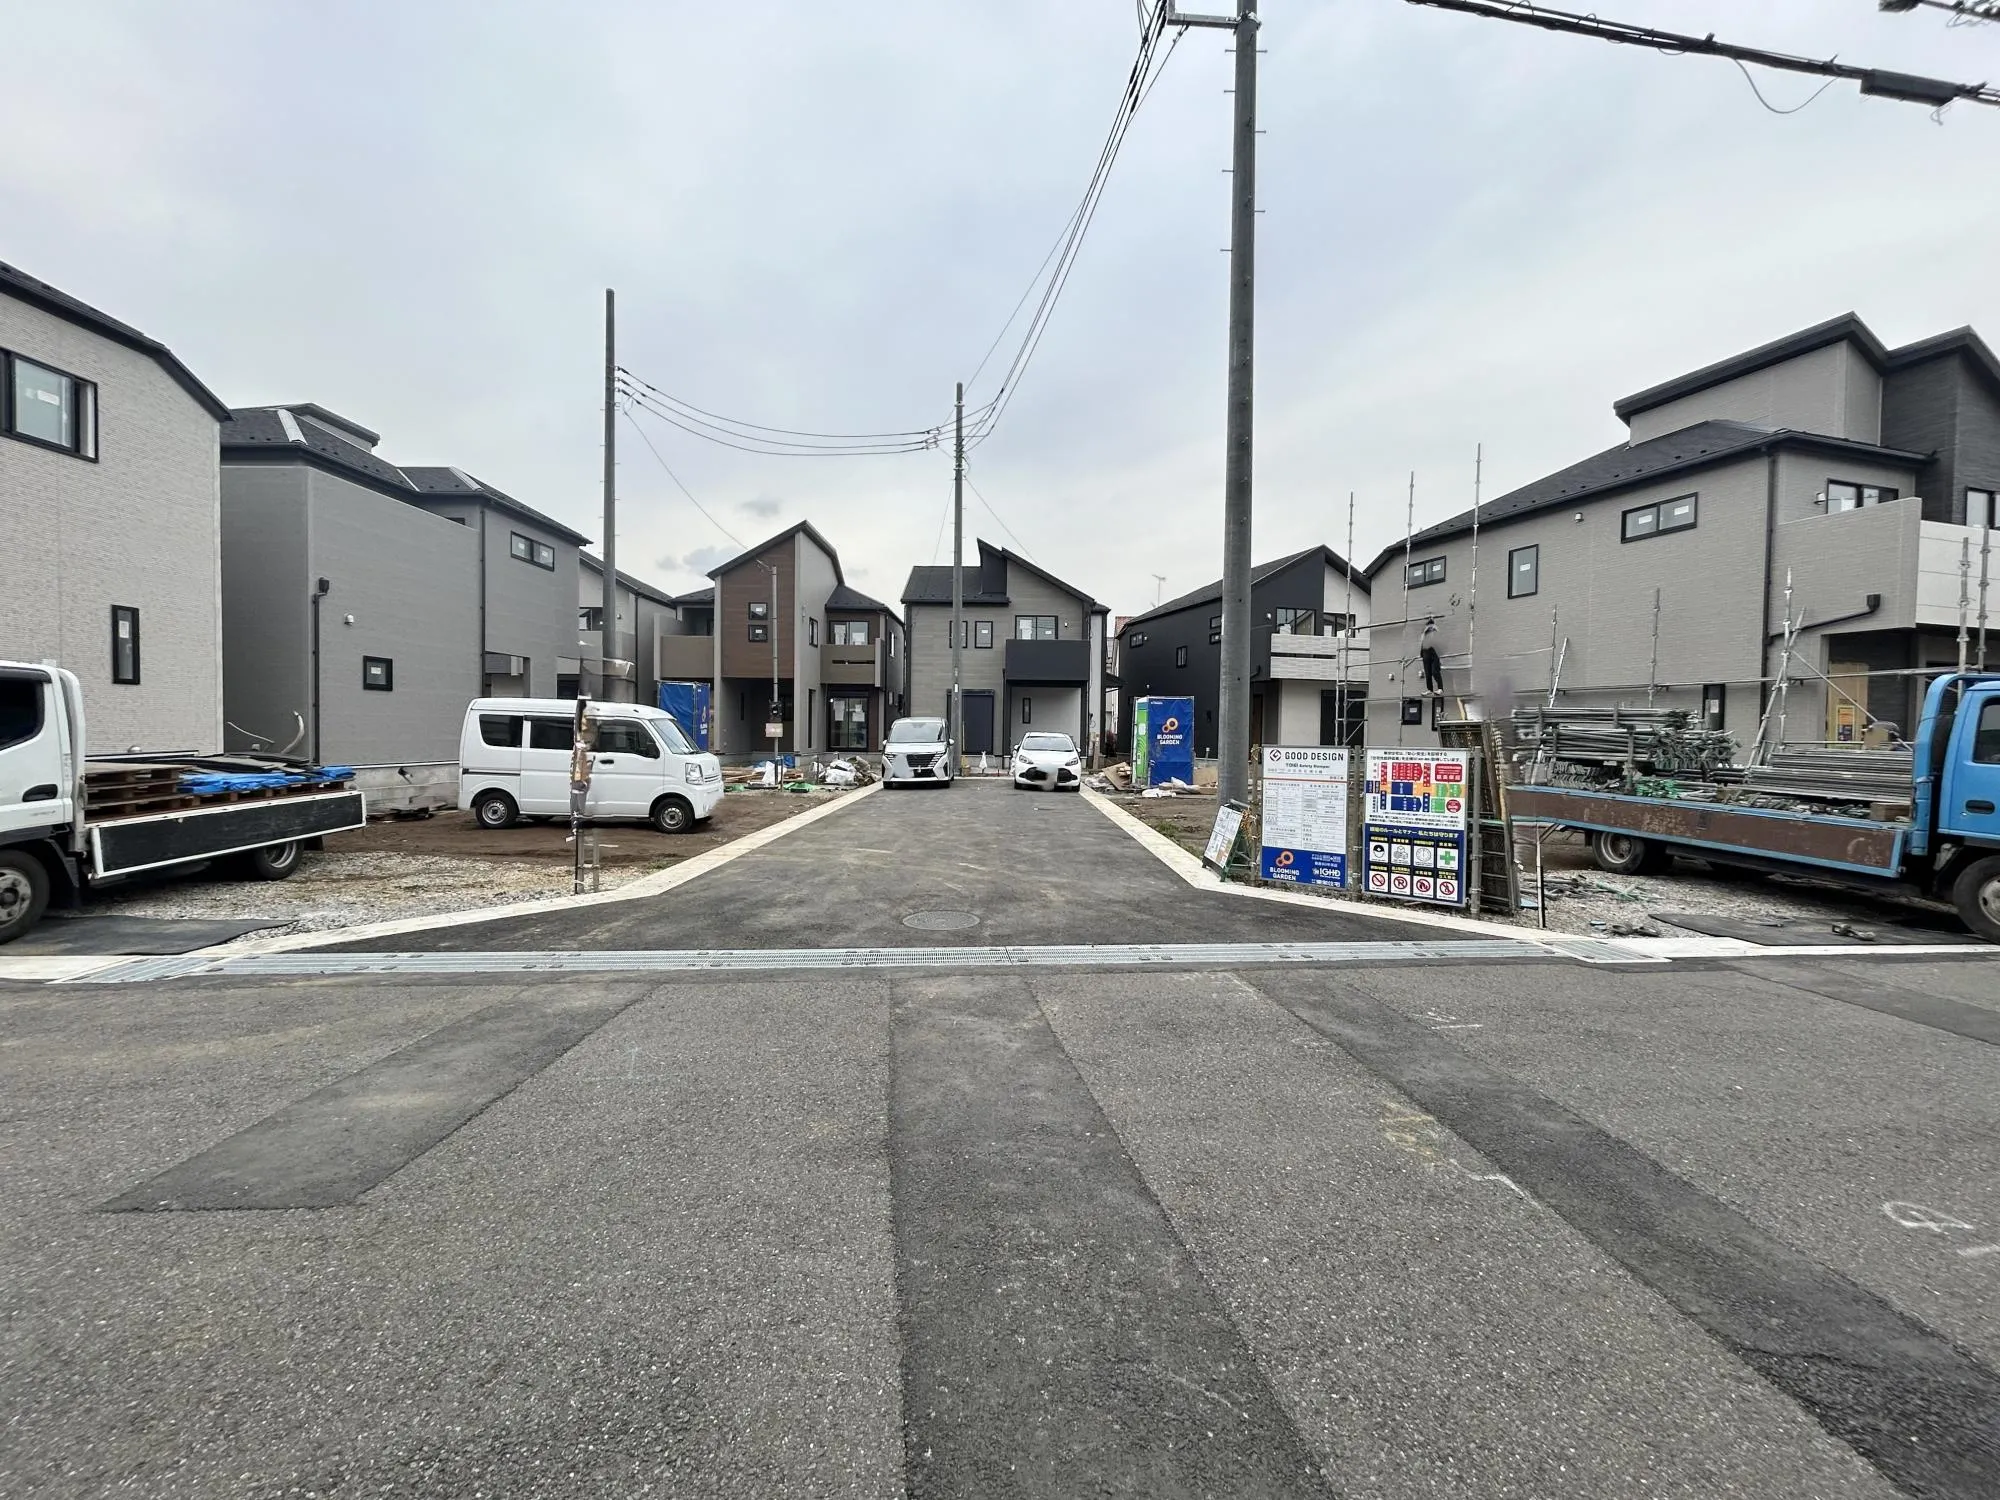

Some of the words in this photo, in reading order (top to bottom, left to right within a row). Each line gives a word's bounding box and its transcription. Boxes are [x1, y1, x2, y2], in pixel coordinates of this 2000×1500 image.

[1285, 751, 1308, 760] GOOD
[1311, 752, 1344, 761] DESIGN
[1418, 830, 1459, 839] 私たちは守ります
[1269, 867, 1300, 876] BLOOMING
[1272, 872, 1297, 881] GARDEN
